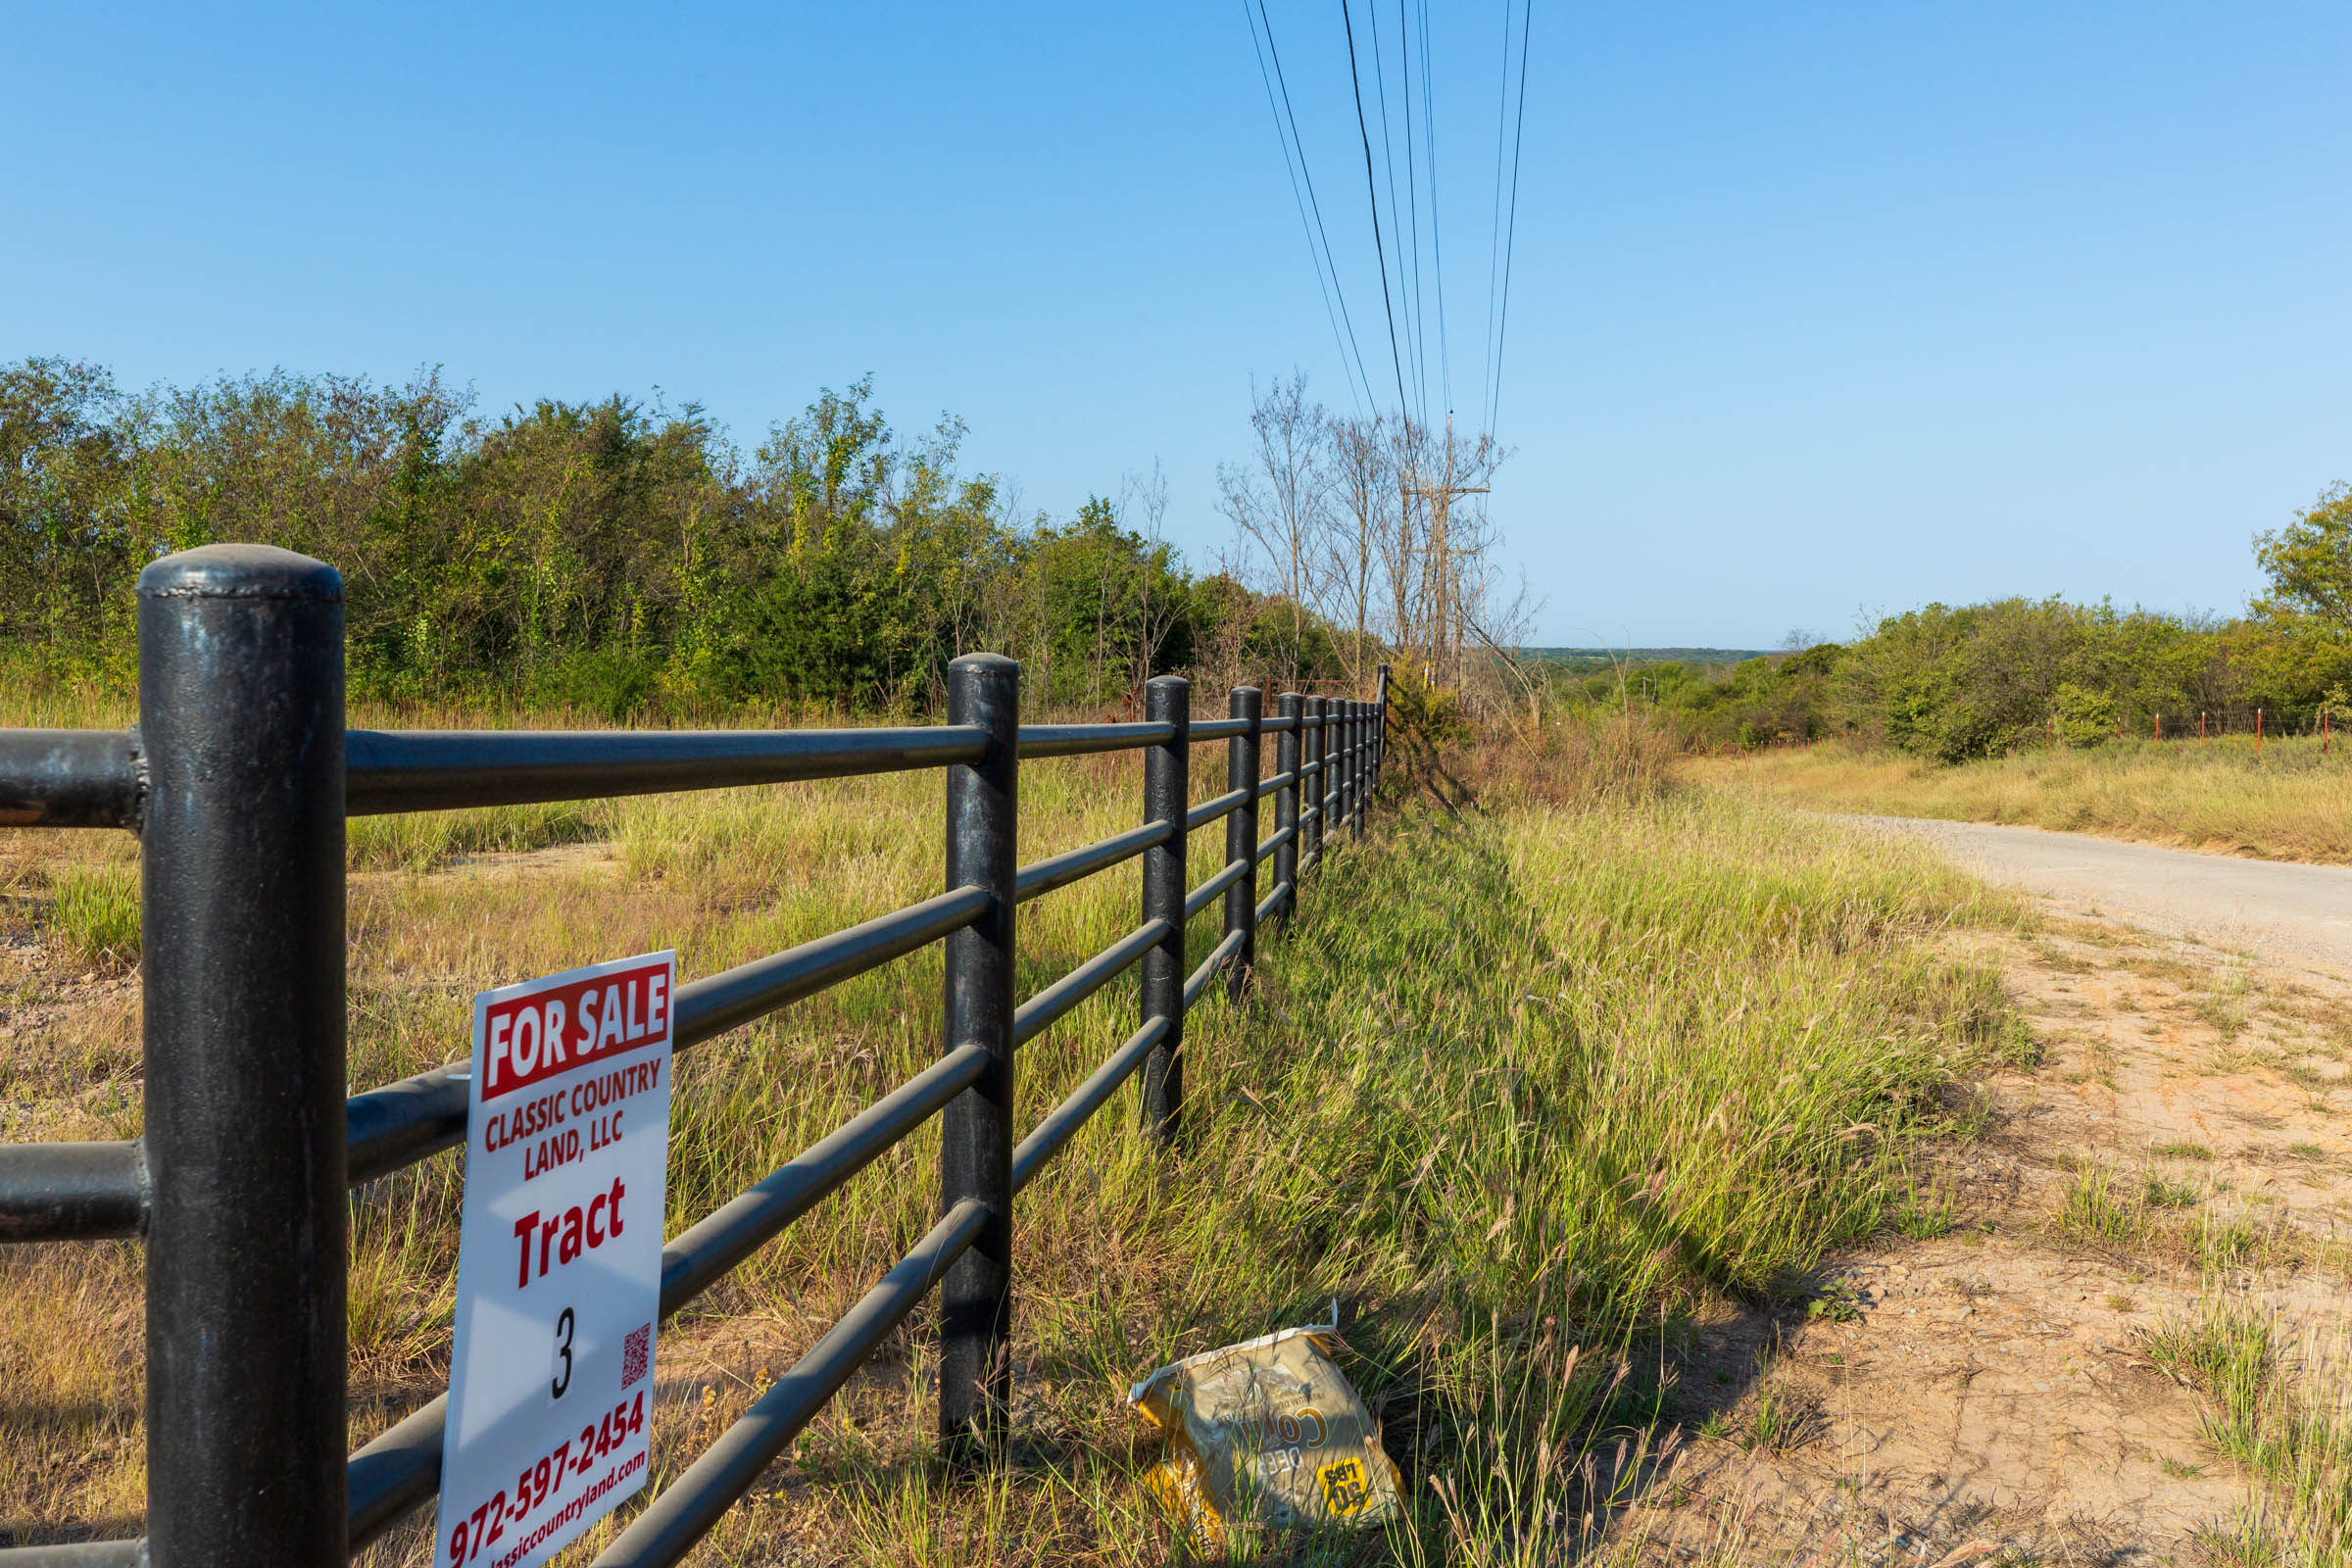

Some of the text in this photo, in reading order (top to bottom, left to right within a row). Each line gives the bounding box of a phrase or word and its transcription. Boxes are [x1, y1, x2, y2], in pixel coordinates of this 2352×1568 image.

[487, 973, 666, 1089] FOR SALE
[485, 1057, 662, 1153] CLASSIC COUNTRY
[524, 1109, 624, 1182] LAND, LLC
[514, 1176, 625, 1289] Tract
[552, 1306, 575, 1399] 3
[449, 1390, 645, 1568] 972-597-2454
